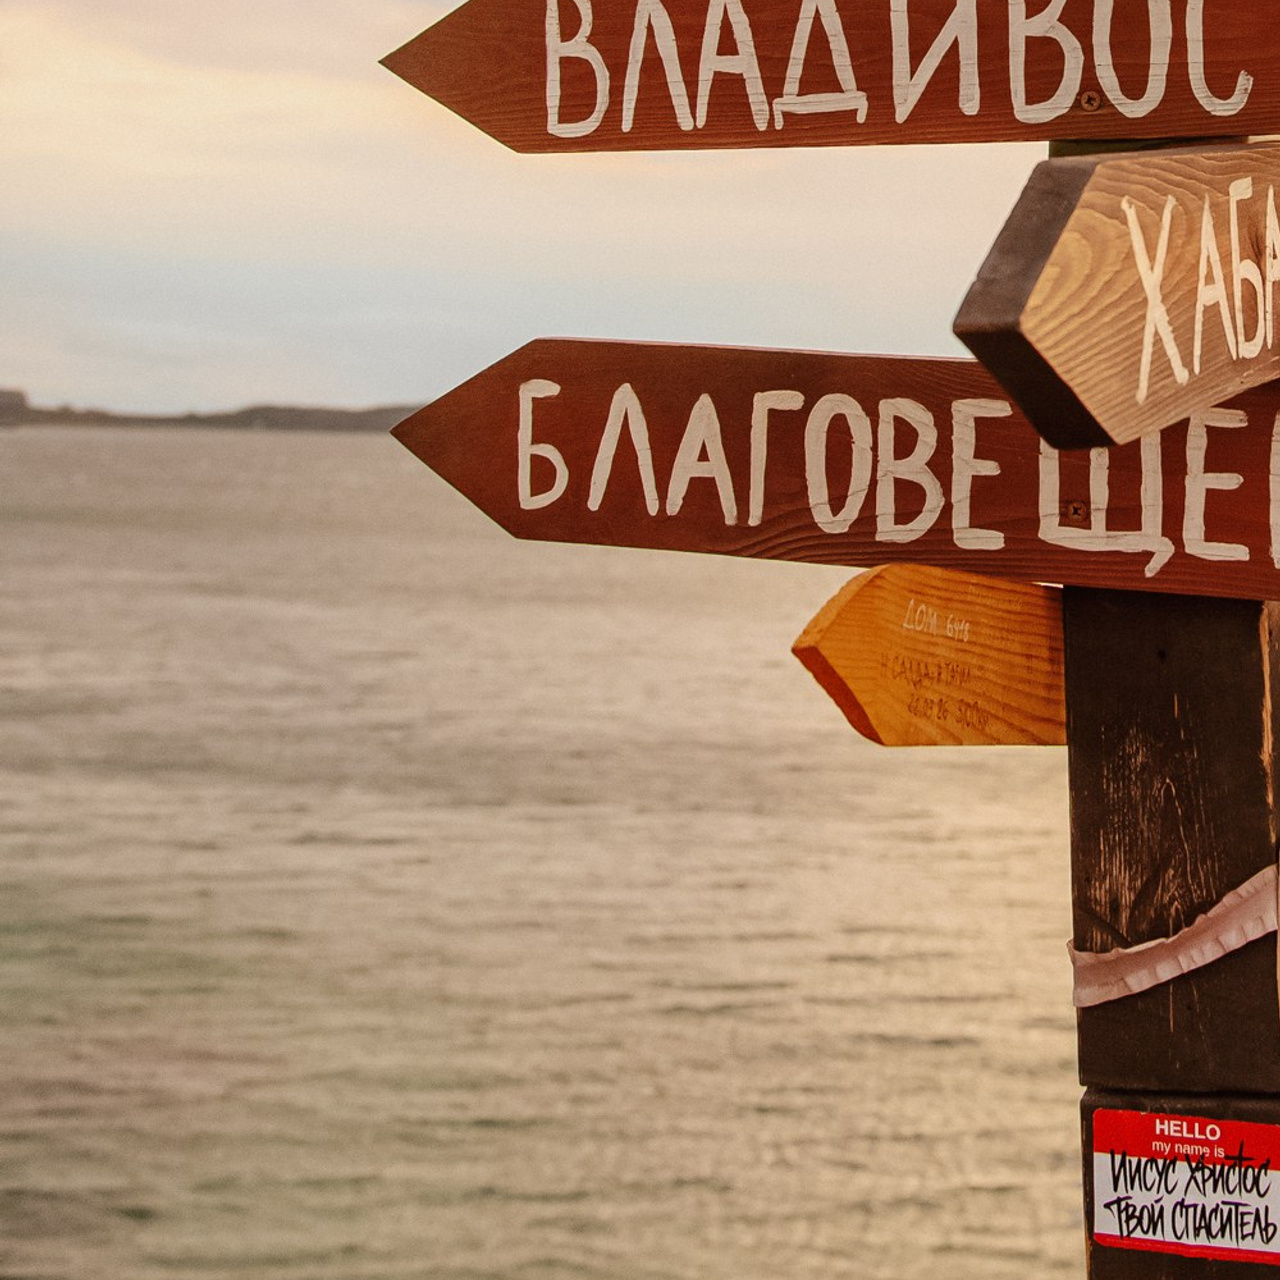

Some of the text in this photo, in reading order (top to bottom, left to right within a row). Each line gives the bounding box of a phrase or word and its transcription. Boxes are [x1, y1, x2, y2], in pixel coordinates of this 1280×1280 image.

[1155, 1119, 1221, 1141] HELLO
[1152, 1140, 1225, 1158] my name is
